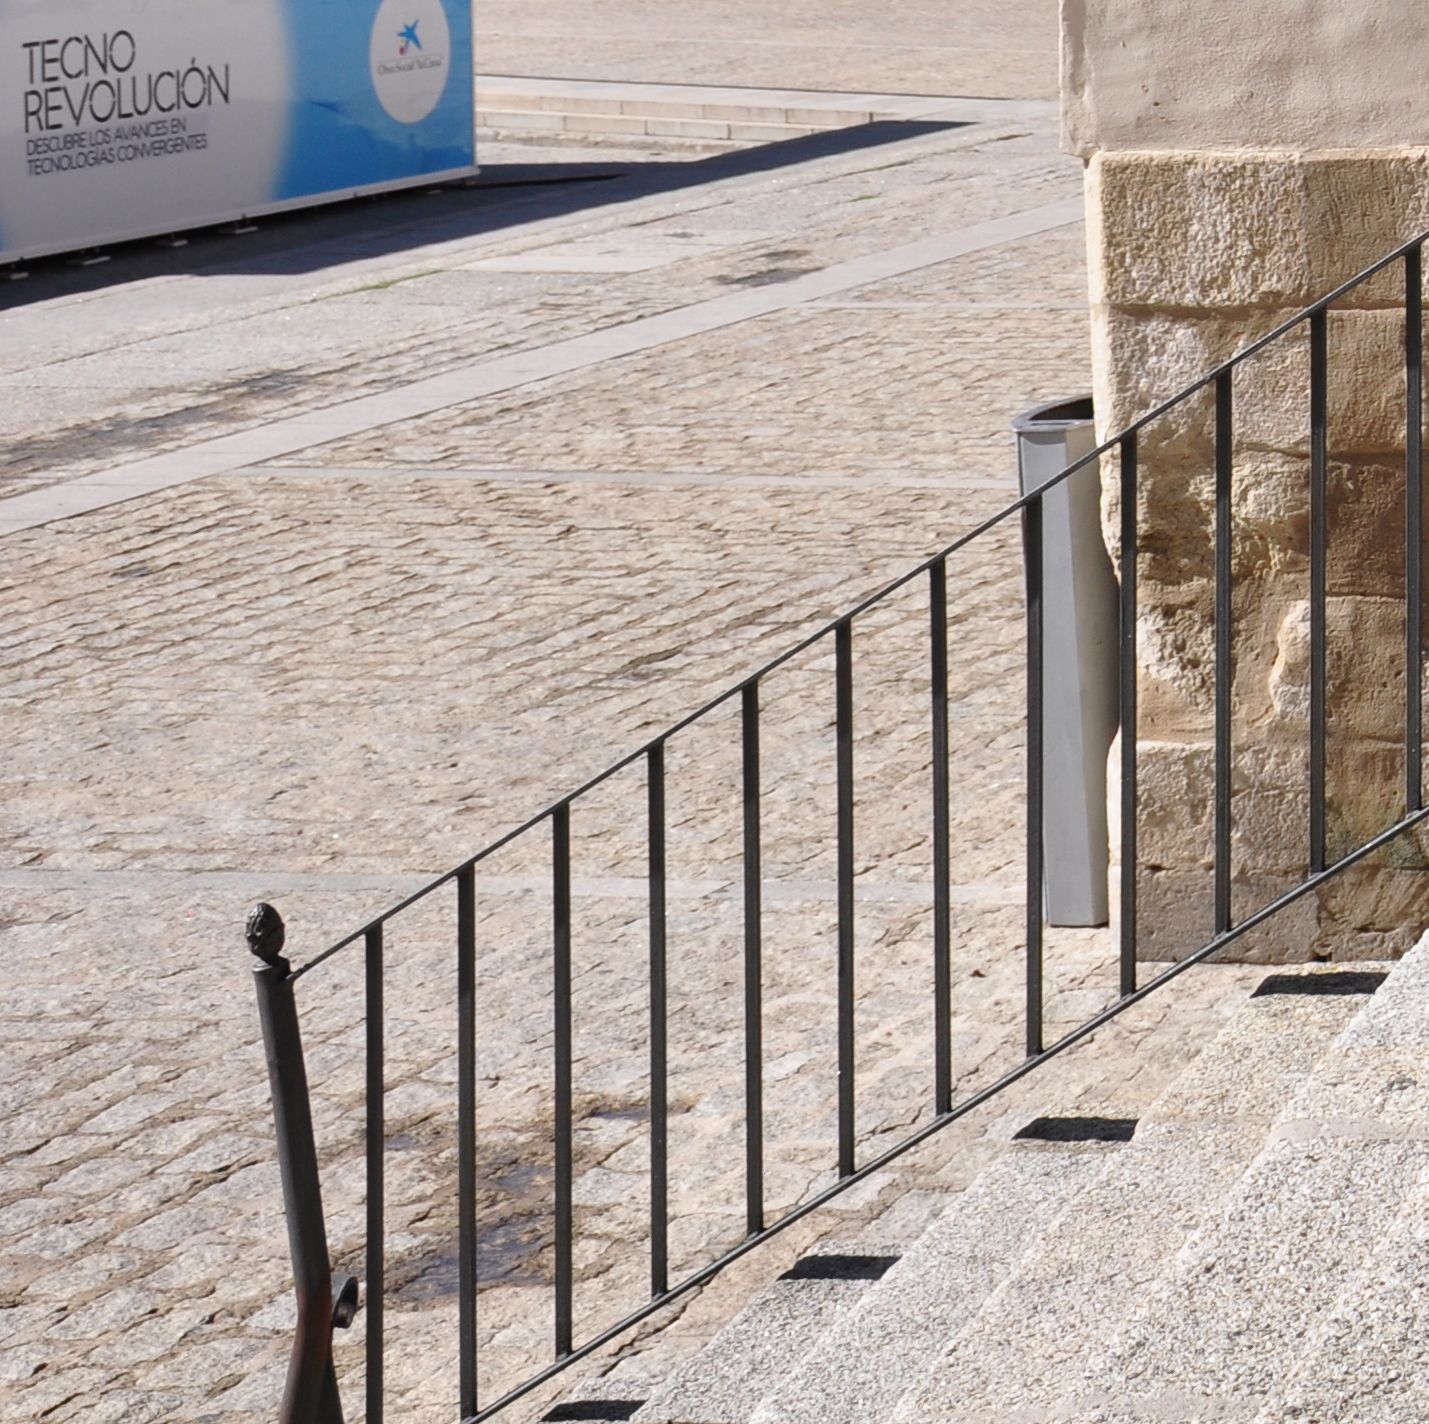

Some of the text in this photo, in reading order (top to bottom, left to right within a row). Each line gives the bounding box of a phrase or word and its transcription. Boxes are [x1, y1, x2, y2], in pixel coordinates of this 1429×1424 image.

[22, 30, 136, 85] TECNO
[24, 57, 230, 133] REVOLUCIÓN
[26, 117, 188, 157] DESCUBRE LOS AVANCES EN
[28, 133, 208, 177] TECNOLOGÍAS CONVERGENTES
